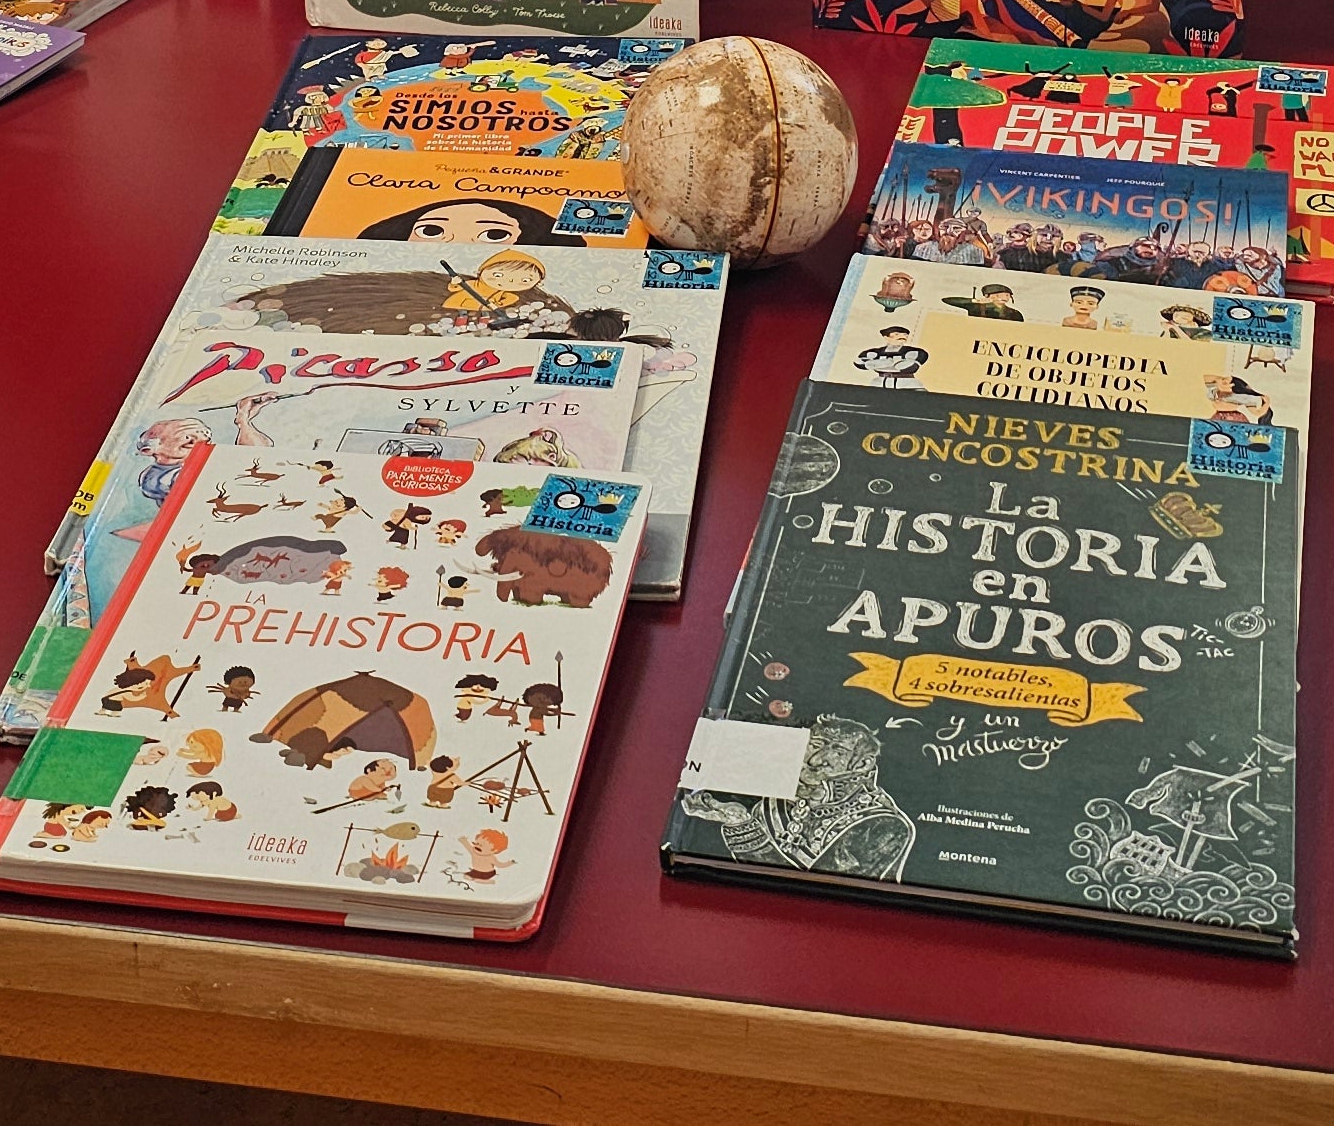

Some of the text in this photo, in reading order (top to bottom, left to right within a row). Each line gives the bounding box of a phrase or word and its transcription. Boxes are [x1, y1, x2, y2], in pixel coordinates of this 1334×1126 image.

[382, 115, 573, 132] NOSOTROS
[388, 100, 517, 115] SIMIOS
[1007, 104, 1212, 146] PEOPLE
[992, 126, 1221, 168] POWER
[347, 172, 627, 199] Clara Campoamo
[971, 178, 1233, 226] ¡VIKINGOS!
[228, 255, 342, 269] & Kate Hindley
[232, 244, 368, 259] Michelle Robinson
[971, 339, 1169, 376] ENCICLOPEDIA
[158, 340, 533, 410] Picasso
[534, 373, 613, 389] Historia
[986, 361, 1147, 393] DE OBJETOS
[398, 398, 582, 417] SYLVETTE
[976, 381, 1149, 414] COTIDIANOS
[946, 411, 1123, 451] NIEVES
[861, 431, 1201, 488] CONCOSTRINA
[386, 471, 462, 485] PARA MENTES
[392, 480, 451, 493] CURIOSAS
[985, 481, 1061, 521] La
[528, 513, 614, 537] Historia
[811, 501, 1227, 590] HISTORIA
[244, 590, 268, 606] LA
[972, 569, 1052, 604] en
[182, 600, 531, 666] PREHISTORIA
[827, 590, 1187, 673] APUROS
[935, 661, 1053, 689] 5 notables,
[908, 677, 1081, 710] 4 sobresalientas
[246, 831, 309, 857] ideaka
